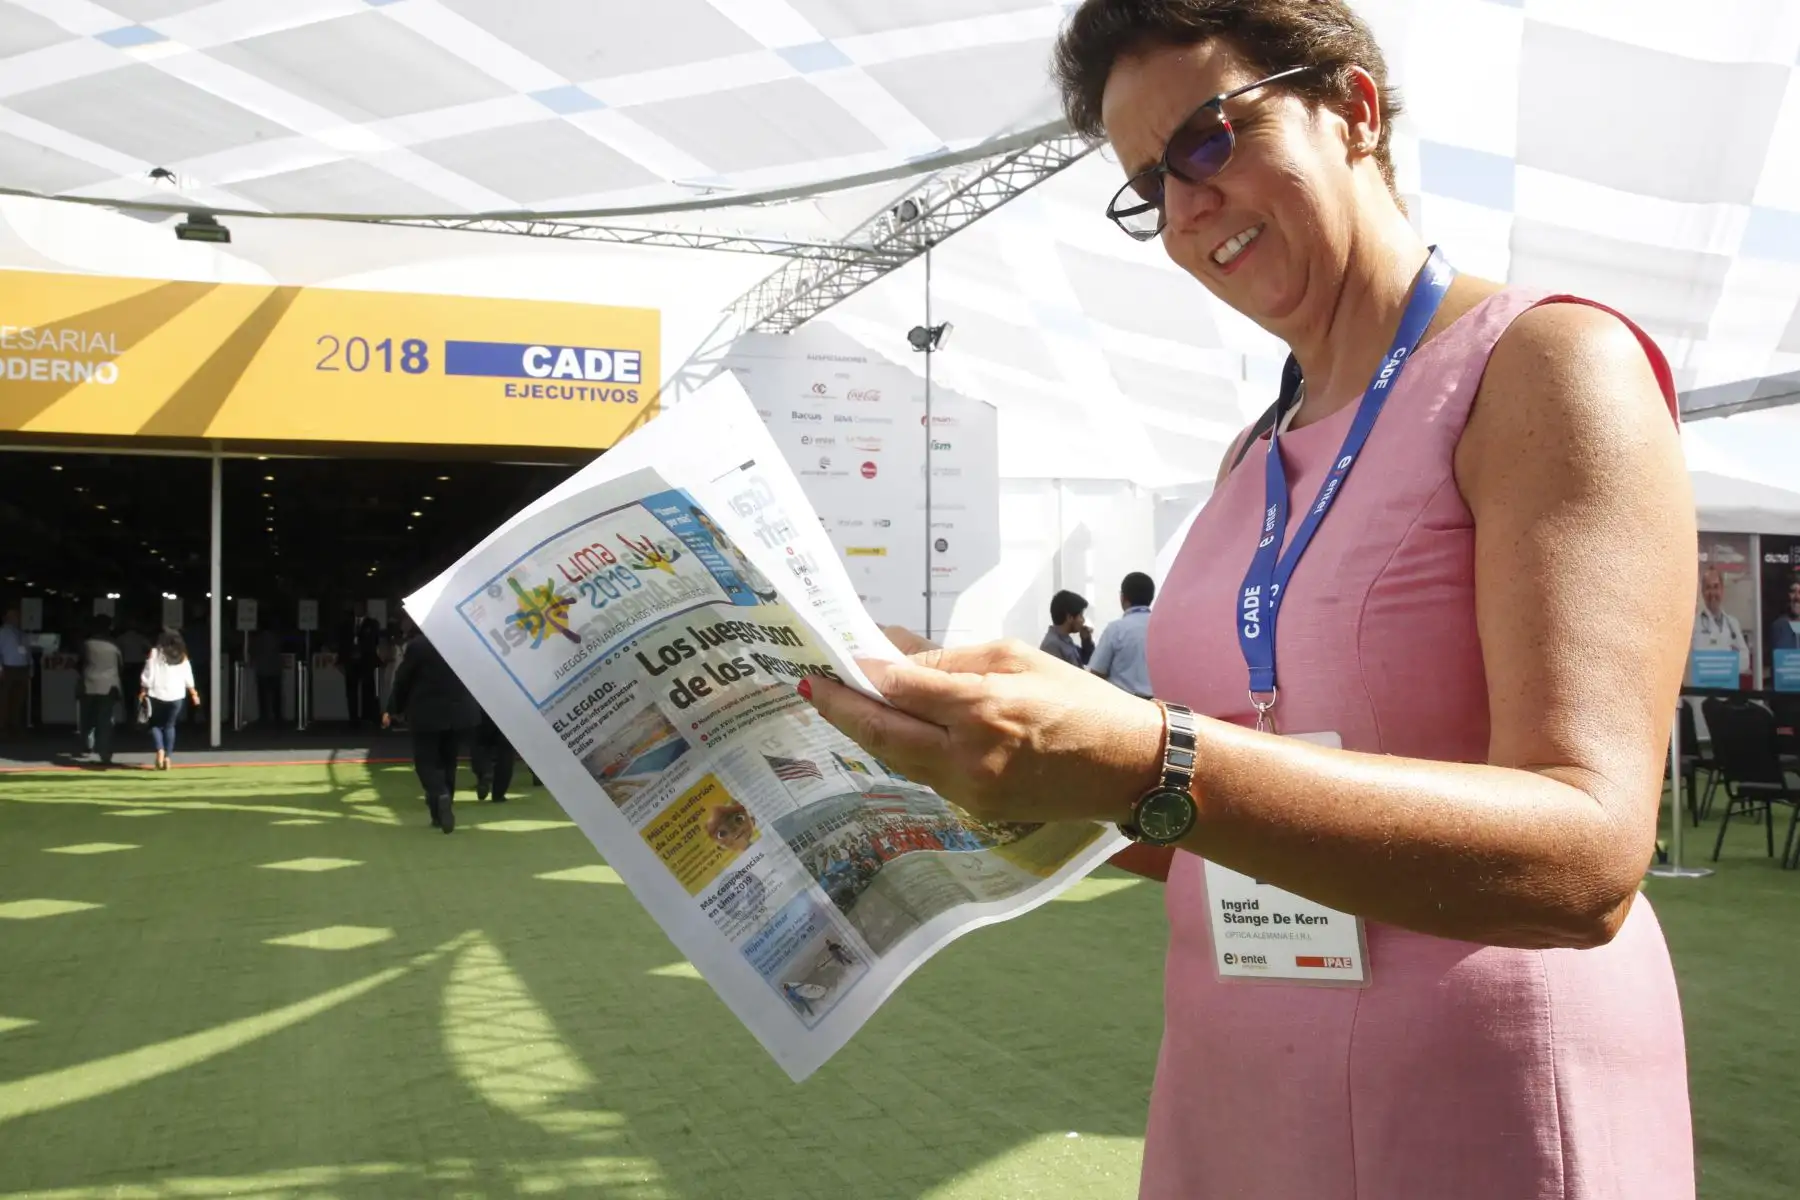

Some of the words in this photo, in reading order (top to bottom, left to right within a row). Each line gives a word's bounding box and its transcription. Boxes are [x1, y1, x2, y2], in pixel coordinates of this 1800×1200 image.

[0, 325, 126, 355] ESARIAL
[315, 335, 429, 374] 2018
[0, 356, 119, 385] DERNO
[521, 346, 640, 382] CADE
[1373, 346, 1407, 390] CADE
[504, 383, 639, 404] EJECUTIVOS
[1313, 478, 1338, 515] entel
[1265, 503, 1277, 532] entel
[579, 565, 642, 609] 2019
[1244, 585, 1261, 639] CADE
[554, 650, 588, 680] JUEGOS
[586, 608, 650, 656] PANAMERICANOS
[635, 638, 696, 676] Los
[686, 620, 766, 650] Juegos
[758, 624, 804, 647] son
[669, 676, 713, 709] de
[701, 657, 756, 687] los
[552, 719, 570, 733] EL
[566, 681, 617, 722] LEGADO:
[560, 723, 581, 741] Obras
[580, 716, 590, 726] de
[588, 679, 638, 719] infraestructura
[568, 721, 598, 748] deportiva
[598, 710, 614, 725] para
[612, 697, 630, 712] Lima
[572, 738, 594, 756] Callao
[680, 783, 715, 813] anfitrión
[662, 842, 683, 860] Lima
[684, 824, 701, 844] 2019
[700, 894, 718, 911] Más
[717, 852, 765, 896] competencias
[708, 908, 719, 918] en
[717, 893, 735, 910] Lima
[735, 876, 752, 893] 2019
[1221, 899, 1260, 912] Ingrid
[1223, 913, 1269, 926] Stange
[1273, 913, 1291, 924] De
[1295, 913, 1328, 925] Kern
[1252, 931, 1289, 940] ALEMANA
[1241, 953, 1267, 965] entel
[1323, 956, 1352, 968] IPAE
